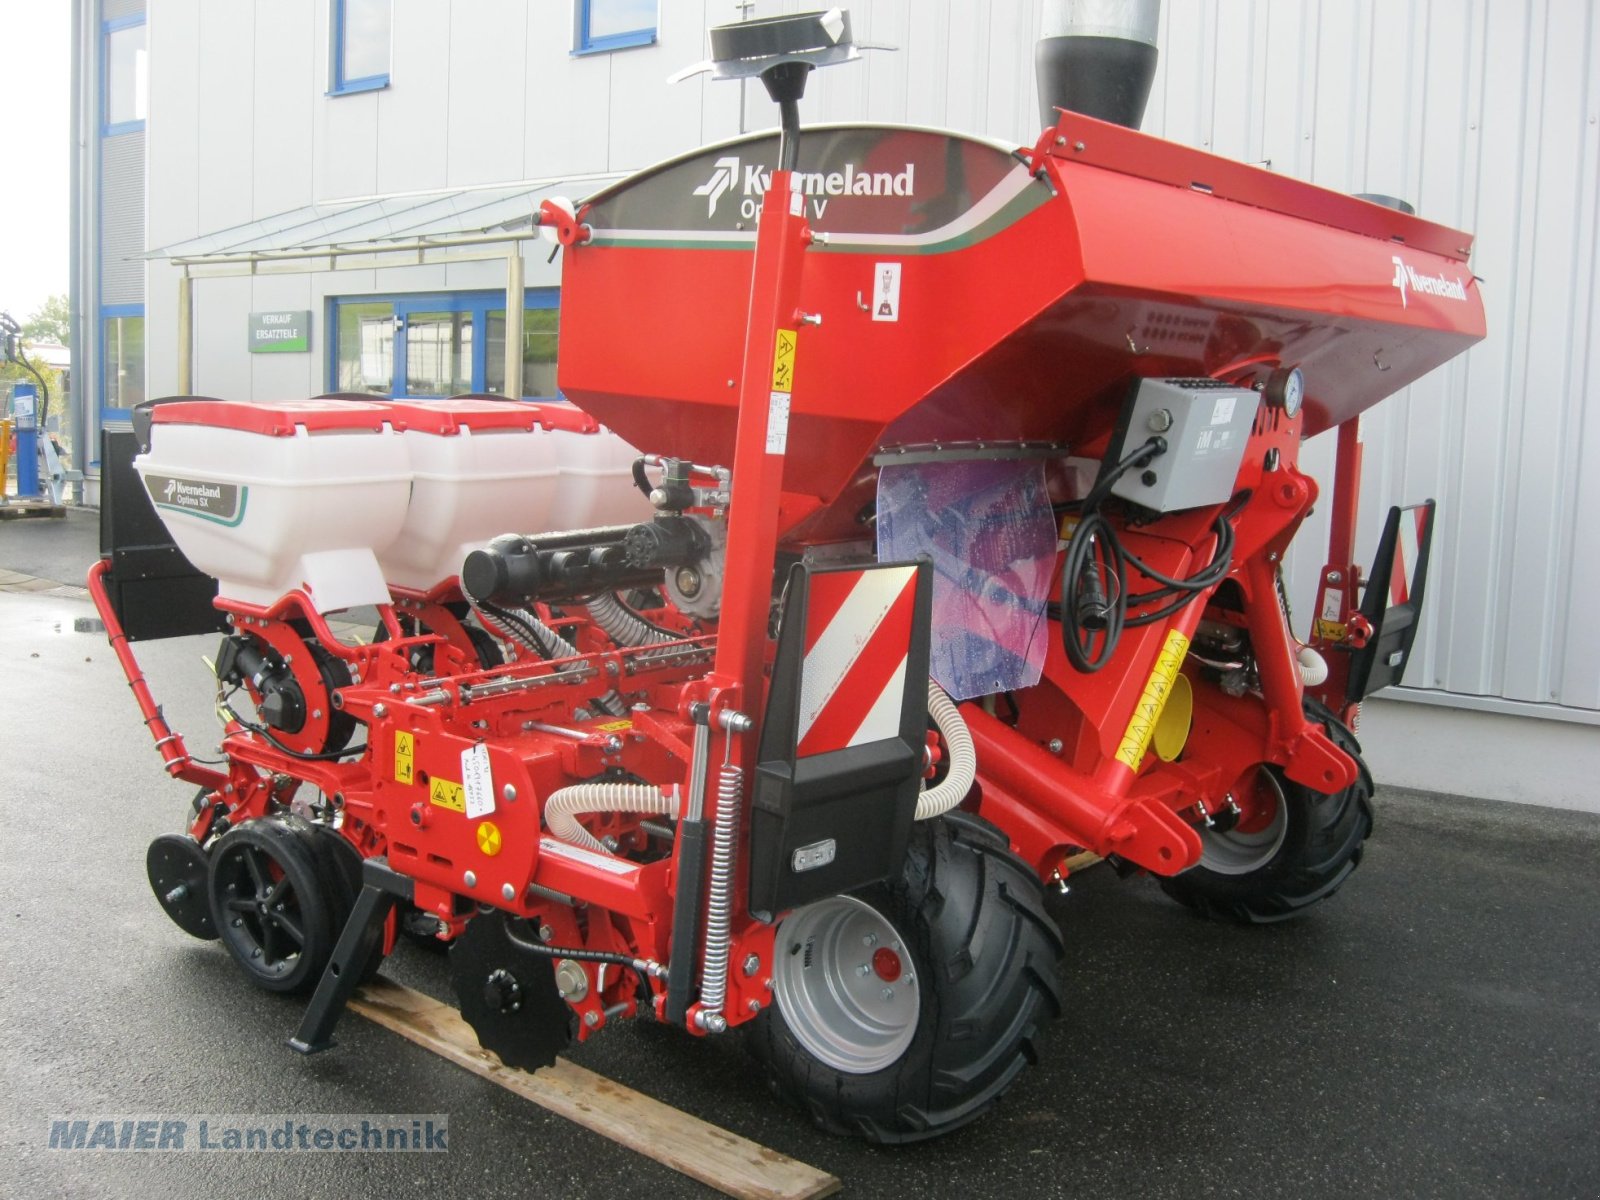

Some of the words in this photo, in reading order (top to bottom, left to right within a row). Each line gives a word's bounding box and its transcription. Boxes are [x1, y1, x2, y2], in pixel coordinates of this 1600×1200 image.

[813, 198, 828, 220] V
[1406, 266, 1467, 300] Kverneland
[262, 314, 292, 324] VERKAUF
[256, 329, 298, 339] ERSATZTEILE
[177, 481, 220, 498] Kverneland
[177, 494, 199, 506] Optima
[199, 497, 209, 507] SX
